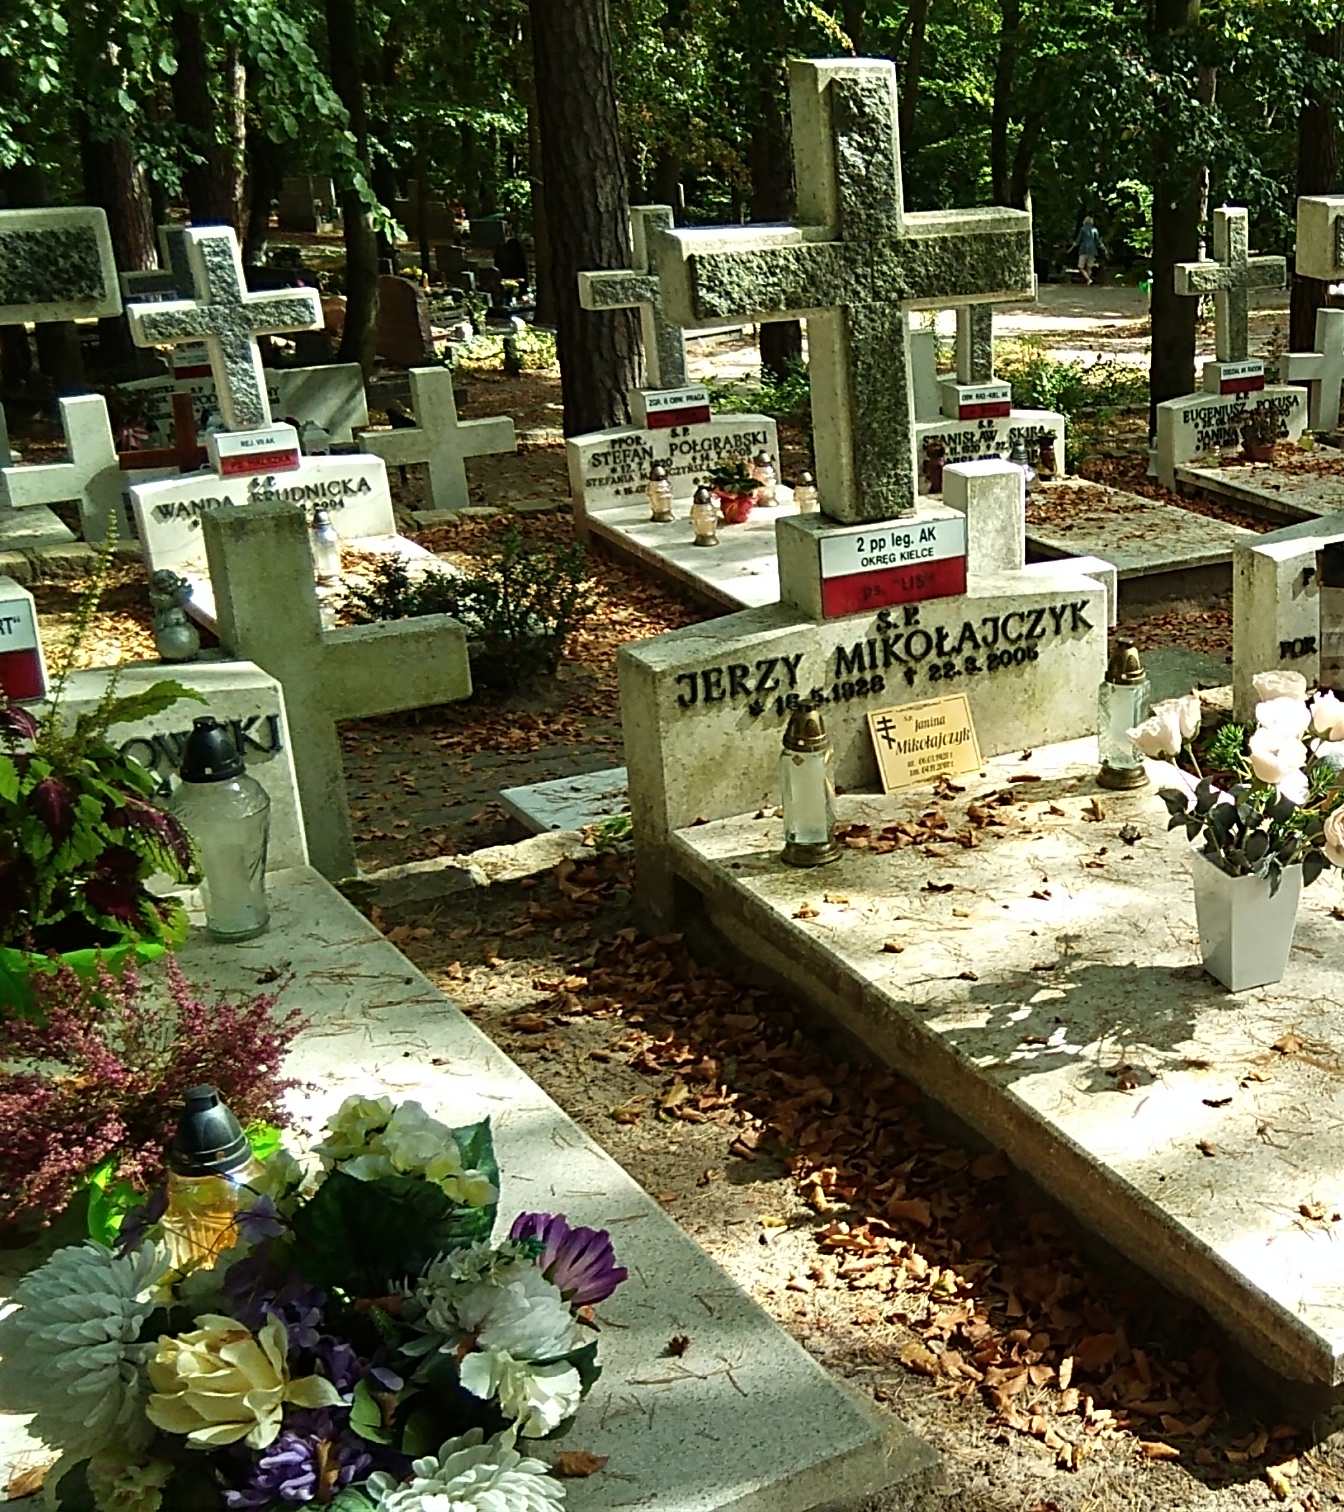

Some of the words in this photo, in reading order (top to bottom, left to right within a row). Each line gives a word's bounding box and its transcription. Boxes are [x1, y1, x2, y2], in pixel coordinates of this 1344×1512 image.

[1183, 402, 1247, 424] EUGENIUSZ
[1257, 394, 1300, 412] POKUSA
[611, 436, 647, 449] PPOR.
[922, 429, 998, 448] STANISŁAW
[592, 445, 654, 468] STEFAN
[586, 474, 635, 487] STEFANIA
[156, 495, 235, 519] WANDA
[856, 537, 865, 553] 2
[870, 537, 887, 553] pp
[891, 532, 915, 549] leg.
[919, 526, 937, 543] AK
[861, 552, 896, 567] OKRĘG
[900, 547, 935, 562] KIELCE
[675, 652, 805, 709] JERZY
[834, 598, 1095, 680] MIKOŁAJCZYK
[914, 715, 946, 733] Janina
[896, 727, 970, 756] Mikołajczyk
